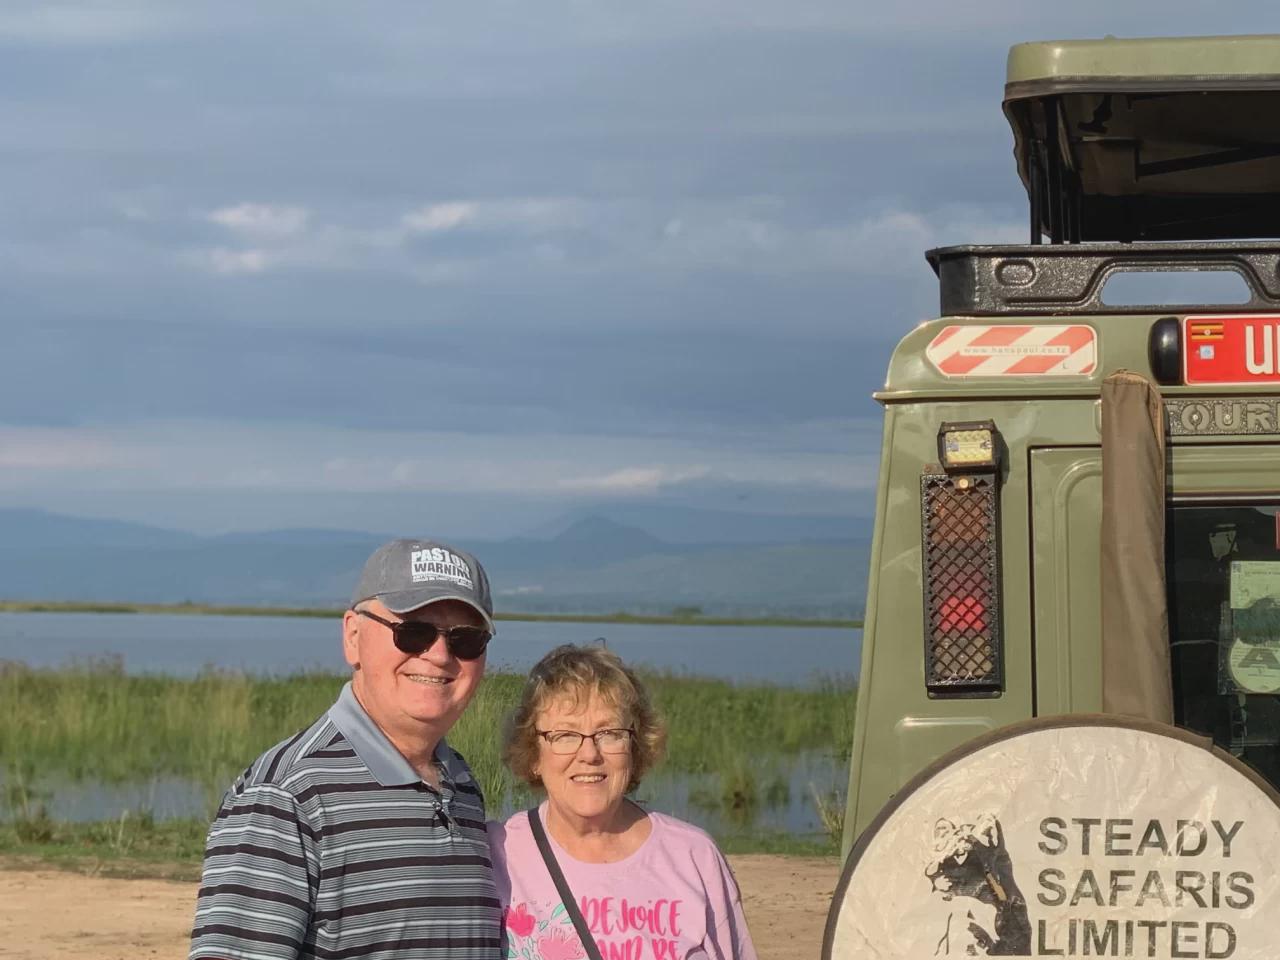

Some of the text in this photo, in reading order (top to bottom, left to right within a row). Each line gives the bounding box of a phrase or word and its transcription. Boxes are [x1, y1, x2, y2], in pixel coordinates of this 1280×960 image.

[1036, 817, 1245, 859] STEADY
[1036, 868, 1256, 910] SAFARIS
[1036, 918, 1238, 960] LIMITED
